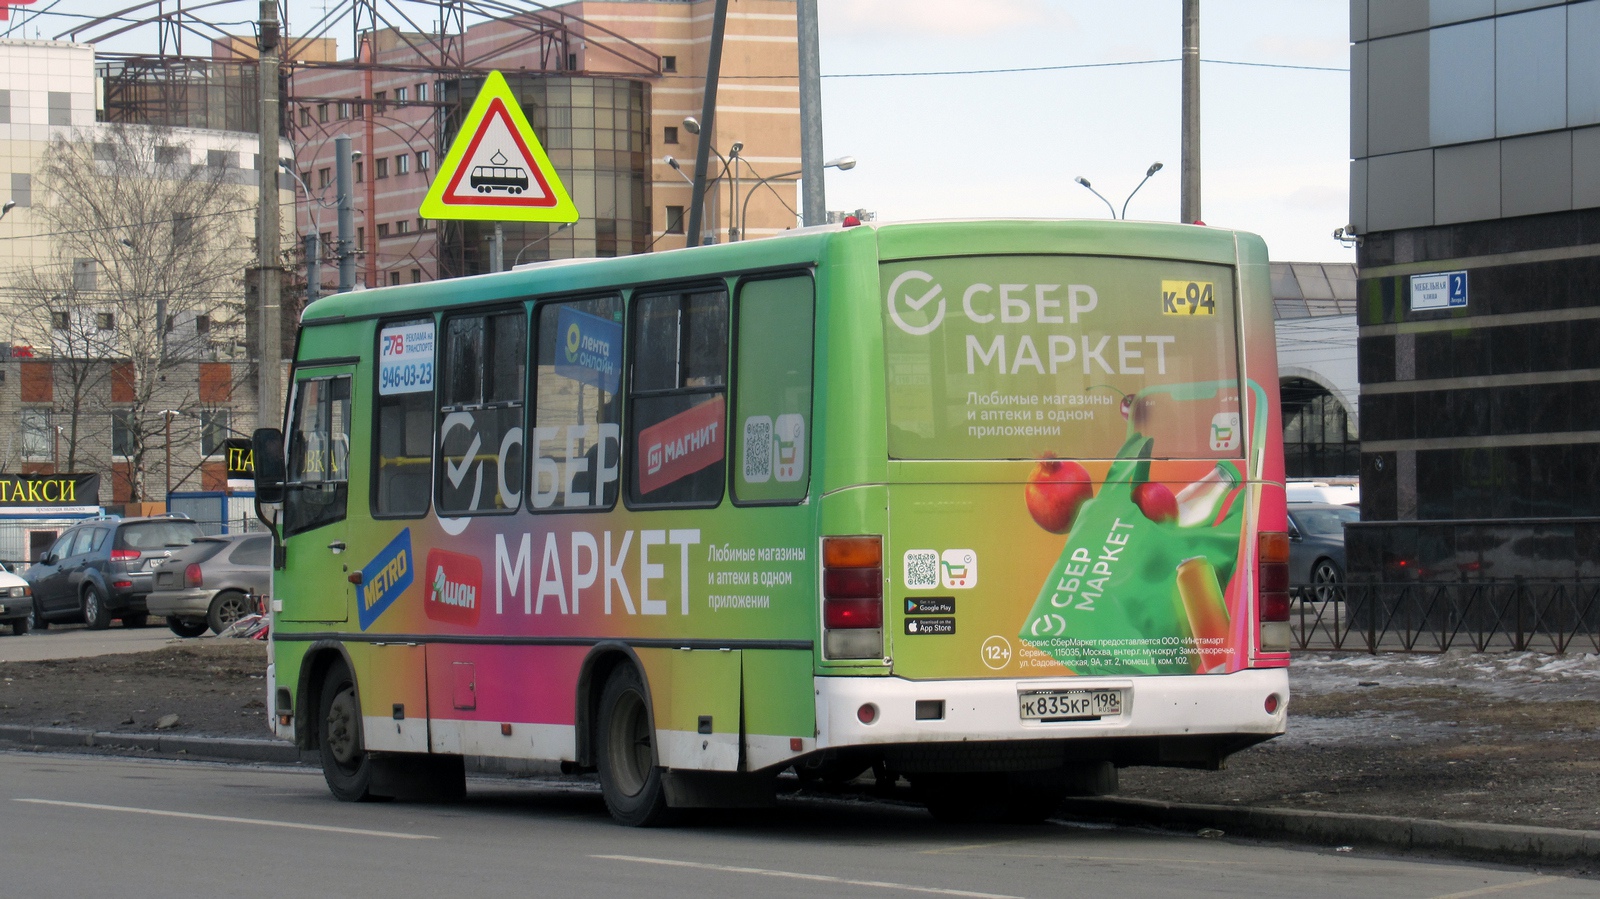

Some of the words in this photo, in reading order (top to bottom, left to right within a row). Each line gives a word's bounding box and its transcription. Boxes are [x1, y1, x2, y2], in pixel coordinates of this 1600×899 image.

[1454, 276, 1462, 295] 2
[962, 283, 1098, 324] СБЕР
[406, 332, 426, 342] РЕКЛАМА
[581, 335, 610, 355] лента
[406, 342, 433, 353] ТРАНСПОРТЕ
[965, 335, 1175, 375] МАРКЕТ
[580, 352, 614, 376] онлайн
[382, 362, 432, 388] 946-03-23
[966, 391, 1038, 406] Любимые
[1043, 393, 1113, 406] магазины
[967, 410, 976, 421] и
[980, 410, 1032, 421] аптеки
[1036, 411, 1044, 420] в
[1049, 411, 1094, 423] одном
[968, 424, 1061, 439] приложении
[664, 422, 719, 463] МАГНИТ
[498, 423, 620, 509] СБЕР
[0, 480, 76, 502] ТАКСИ
[708, 544, 756, 562] Любимые
[758, 544, 806, 561] магазины
[495, 529, 701, 615] МАРКЕТ
[1074, 518, 1134, 611] МАРКЕТ
[363, 549, 406, 611] METRO
[431, 565, 476, 609] Ашан
[708, 573, 715, 585] и
[716, 572, 750, 586] аптеки
[752, 573, 759, 584] в
[760, 572, 792, 588] одном
[1050, 547, 1092, 608] СБЕР
[708, 594, 770, 612] приложении
[920, 604, 939, 612] Google
[940, 604, 952, 612] Play
[920, 624, 933, 633] App
[934, 624, 952, 632] Store
[1050, 637, 1096, 648] СберМаркет
[1099, 638, 1160, 647] предоставляется
[1162, 636, 1180, 645] ООО
[1180, 637, 1224, 646] «Инстамарт
[985, 645, 1010, 660] 12+
[1054, 648, 1081, 658] 115035,
[1082, 648, 1112, 658] Москва,
[1031, 659, 1089, 668] Садовническая,
[1026, 696, 1090, 716] К835КР
[1094, 693, 1117, 707] 198
